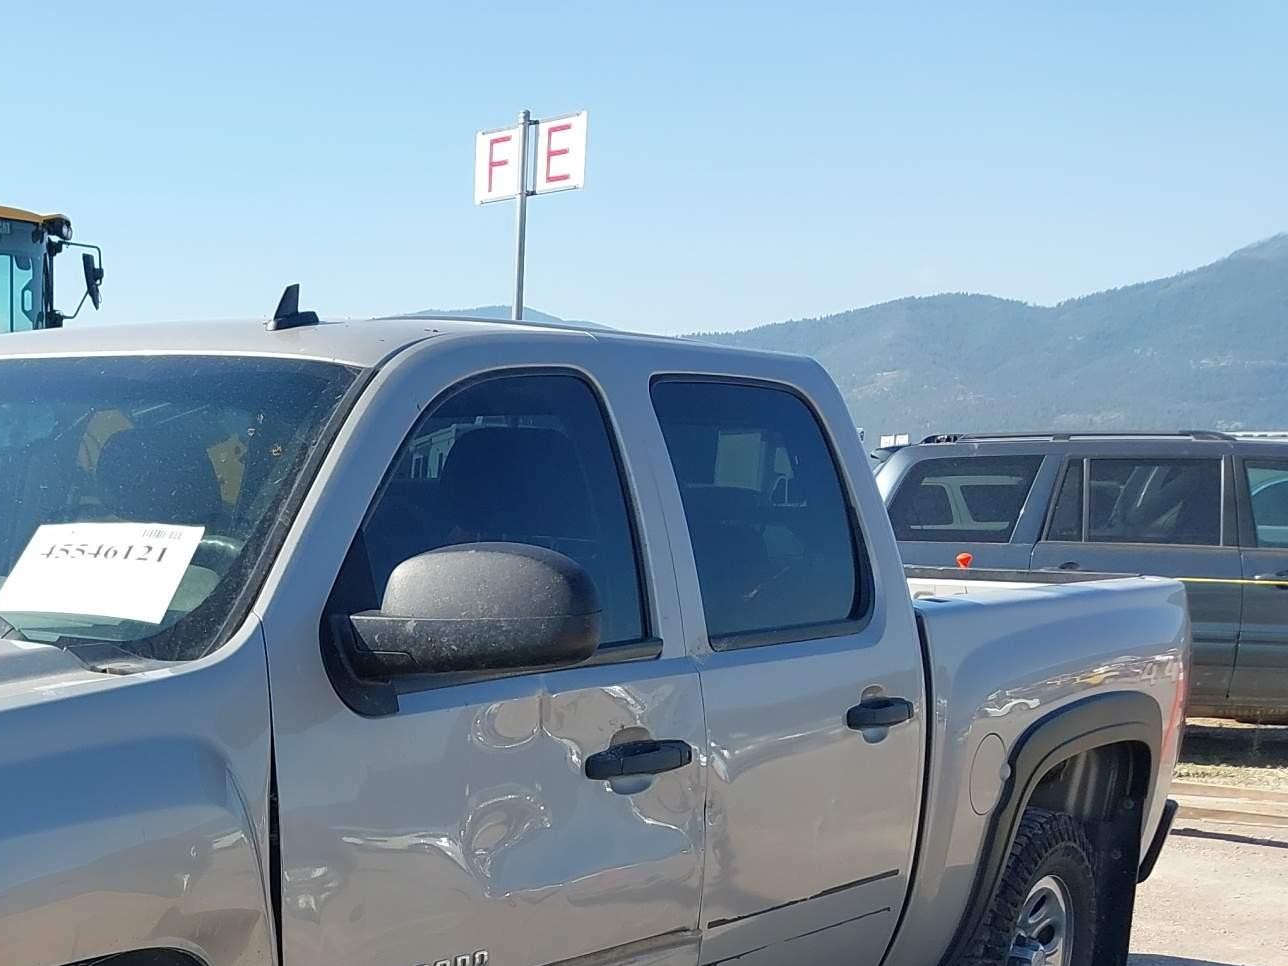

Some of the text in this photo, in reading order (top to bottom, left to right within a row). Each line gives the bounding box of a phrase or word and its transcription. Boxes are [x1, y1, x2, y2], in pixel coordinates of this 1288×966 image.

[488, 135, 512, 193] F
[546, 123, 572, 183] E
[40, 544, 168, 562] 45546121
